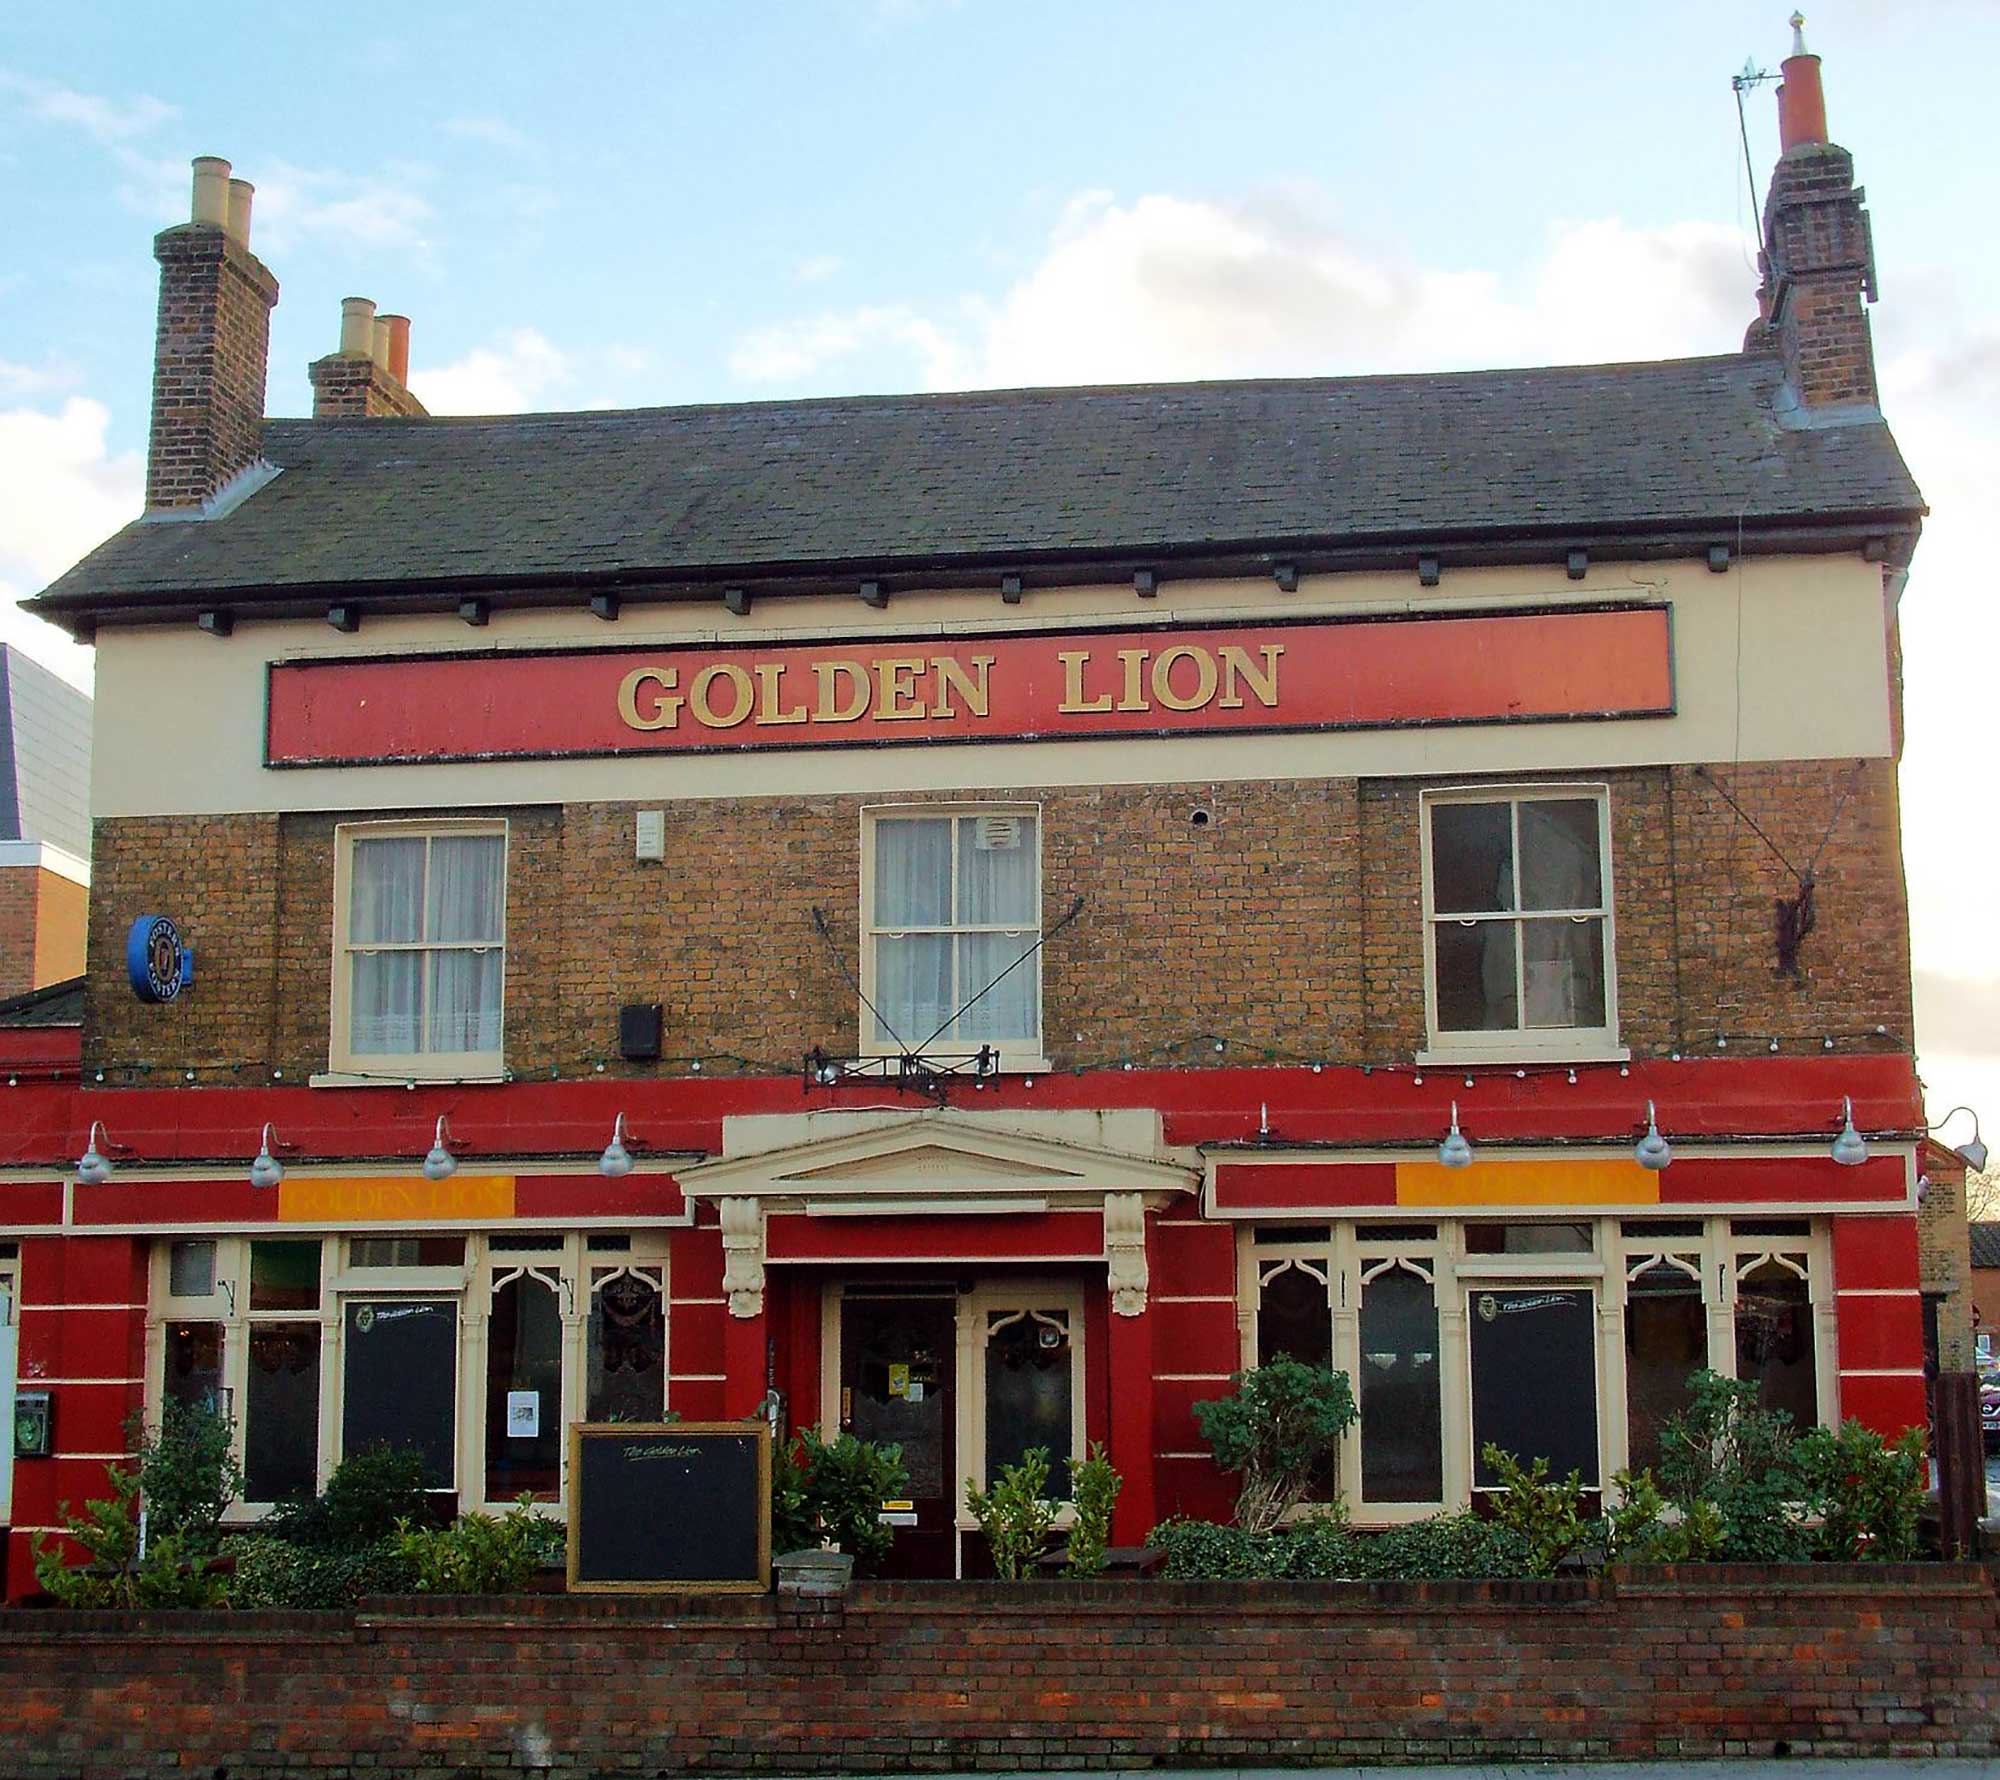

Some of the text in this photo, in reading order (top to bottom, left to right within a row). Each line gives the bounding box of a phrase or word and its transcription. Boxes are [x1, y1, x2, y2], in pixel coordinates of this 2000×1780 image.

[617, 644, 1285, 731] GOLDEN LION
[286, 1180, 506, 1212] GOLDEN LION
[623, 1446, 642, 1457] The
